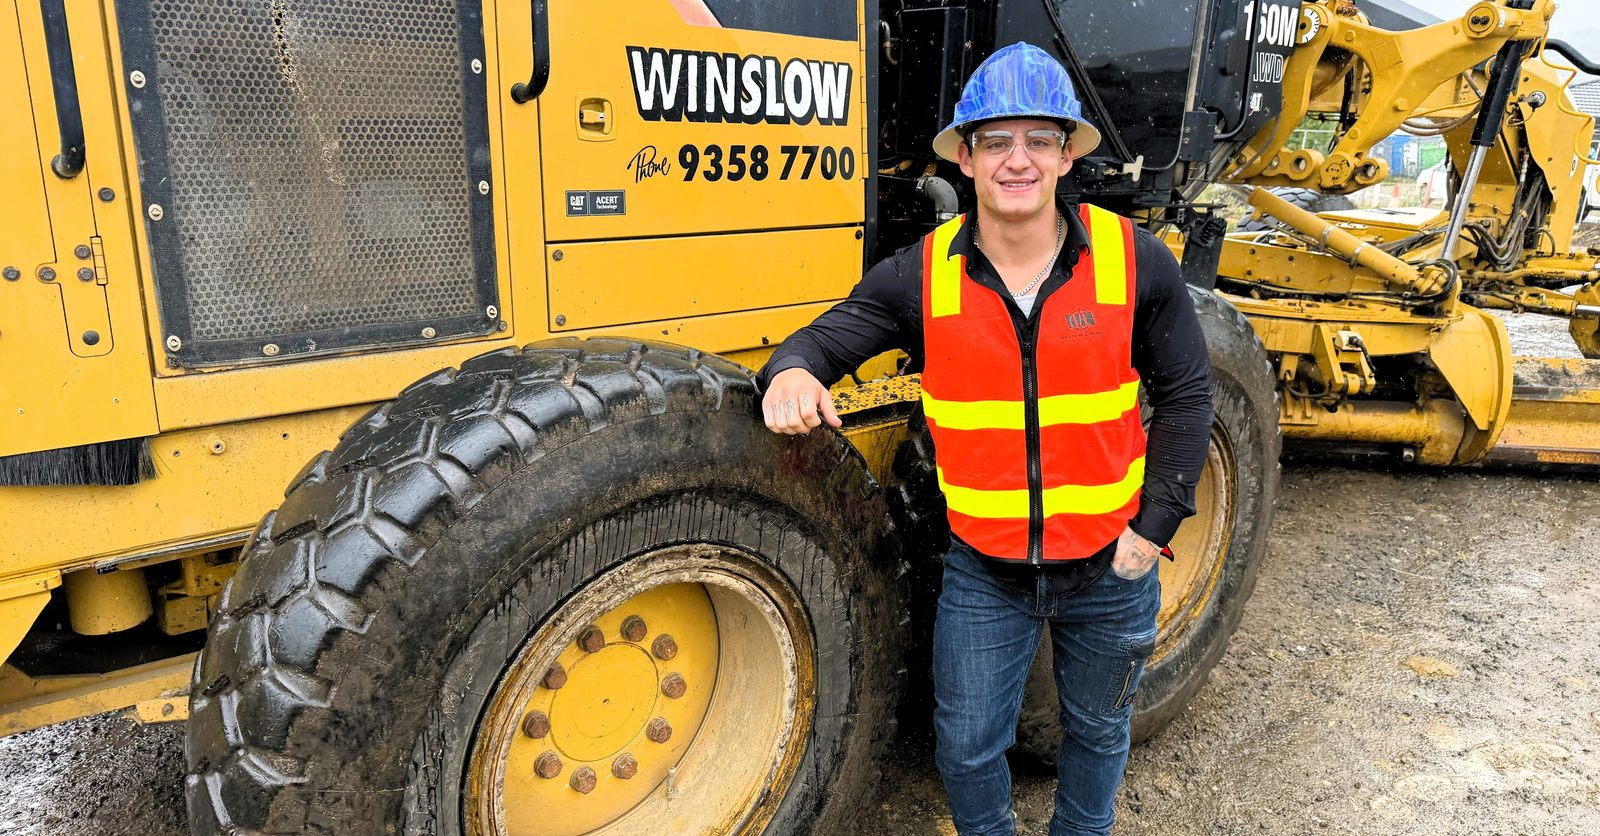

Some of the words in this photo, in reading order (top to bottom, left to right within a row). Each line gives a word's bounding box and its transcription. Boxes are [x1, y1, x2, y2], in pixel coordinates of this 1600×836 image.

[626, 46, 852, 124] WINSLOW
[626, 145, 672, 183] Phone
[678, 144, 769, 181] 9358
[779, 145, 855, 181] 7700
[570, 195, 585, 206] CAT
[595, 195, 618, 204] ACERT
